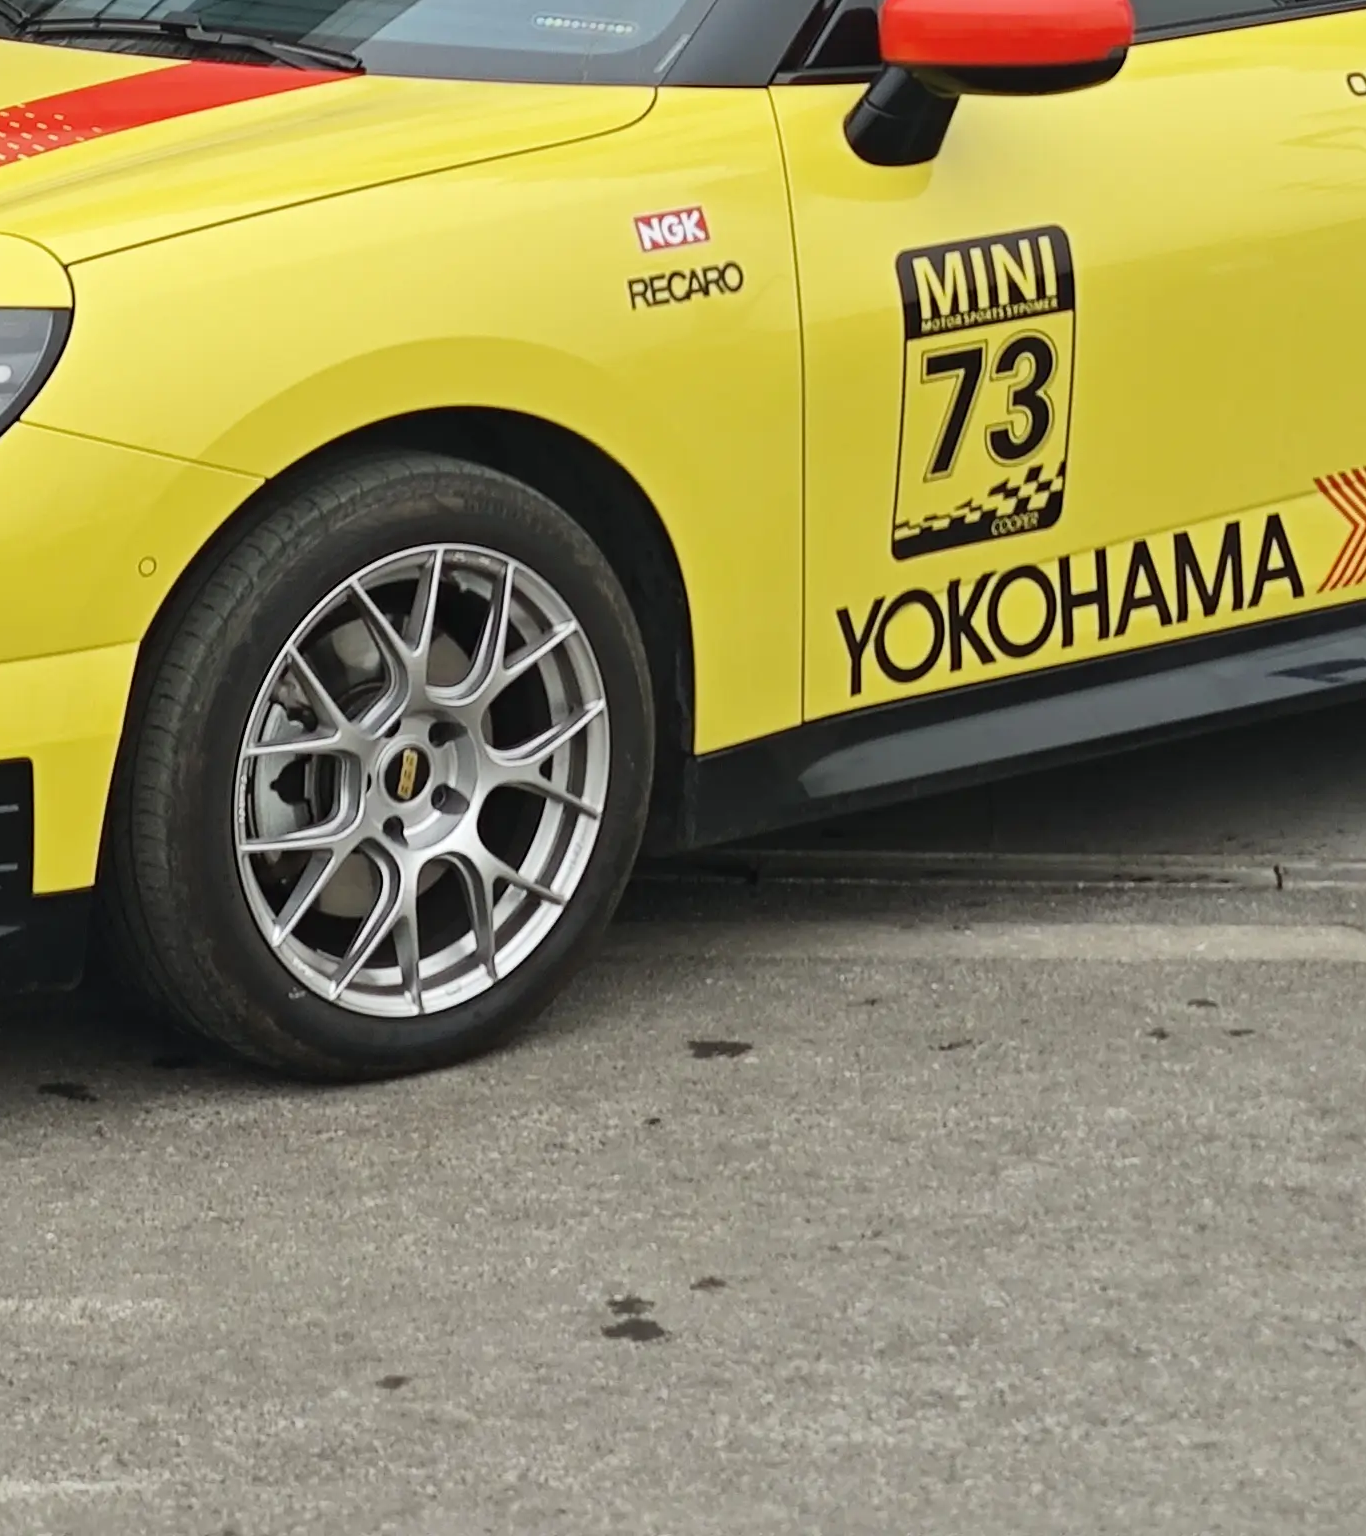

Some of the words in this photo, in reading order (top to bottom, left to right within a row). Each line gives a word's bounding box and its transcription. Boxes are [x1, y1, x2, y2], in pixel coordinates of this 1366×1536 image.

[637, 210, 707, 250] NGK
[627, 260, 744, 311] RECARO
[912, 234, 1058, 321] MINI
[921, 328, 1059, 483] 73
[836, 512, 1305, 698] YOKOHAMA
